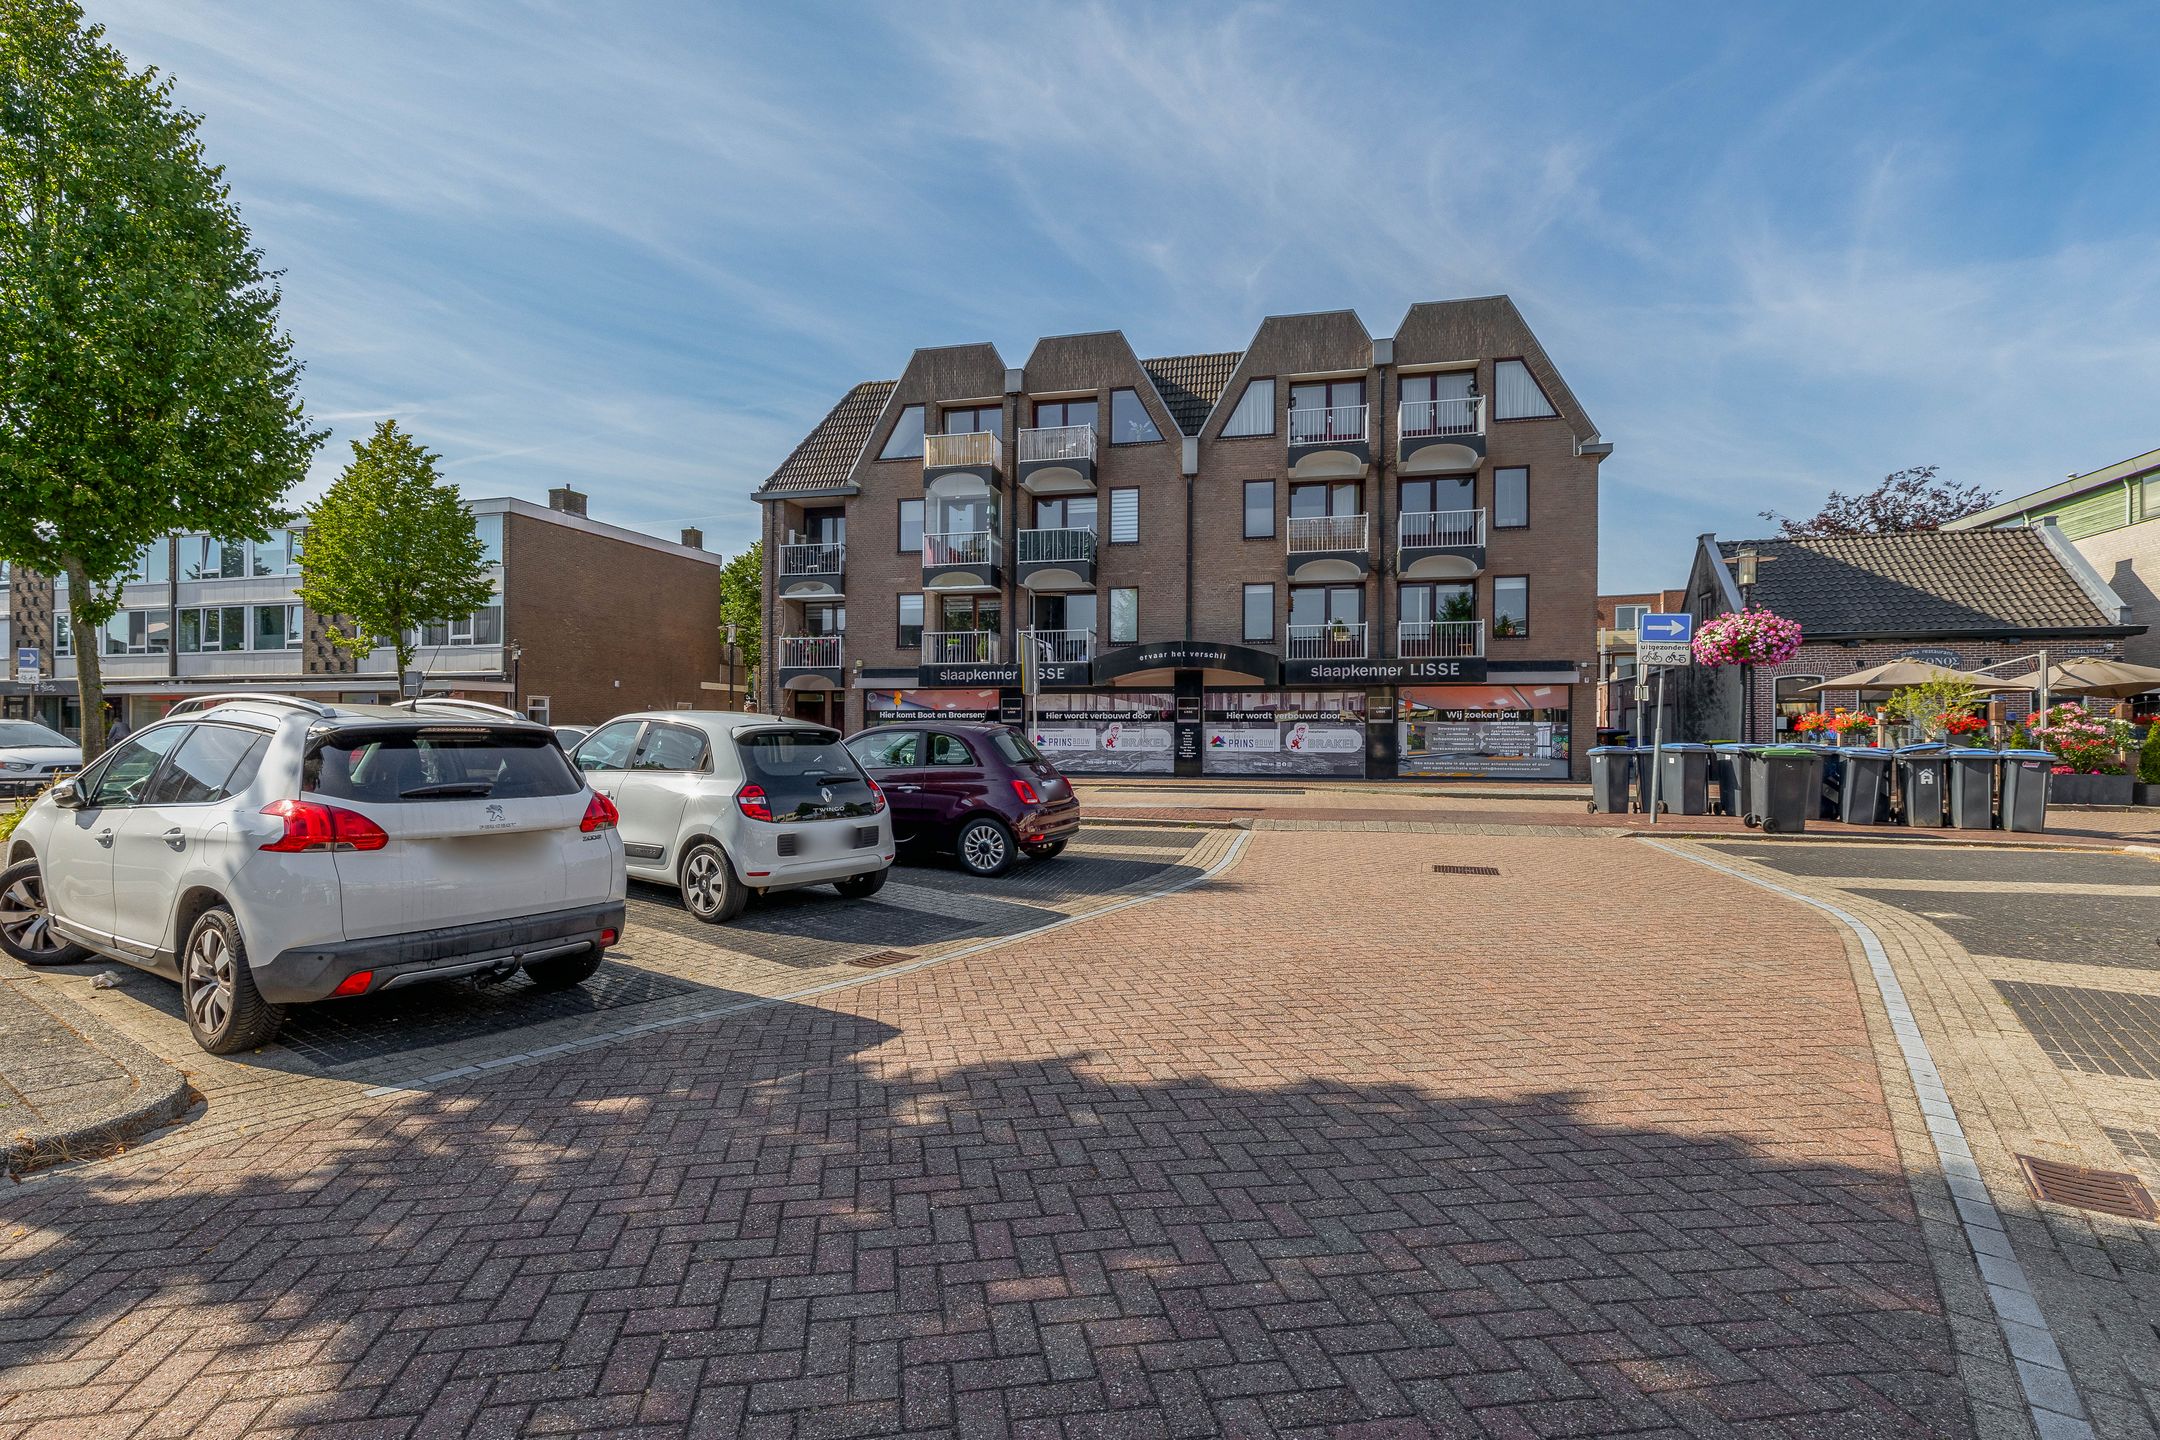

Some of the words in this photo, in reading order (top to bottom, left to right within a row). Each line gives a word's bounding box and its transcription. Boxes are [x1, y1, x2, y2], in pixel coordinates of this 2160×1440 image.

[1139, 651, 1168, 661] ervaar
[1189, 651, 1226, 660] verschil
[939, 669, 1018, 682] slaapkenner
[1038, 667, 1065, 680] SSE
[1310, 664, 1404, 679] slaapkenner
[1410, 662, 1460, 677] LISSE
[879, 711, 896, 719] Hier
[896, 711, 916, 719] komt
[917, 711, 936, 719] Boot
[948, 711, 985, 719] Broersen:
[1045, 711, 1063, 719] Hier
[1063, 711, 1088, 719] wordt
[1089, 711, 1131, 719] verbouwd
[1132, 711, 1152, 719] door
[1226, 711, 1244, 719] Hier
[1245, 711, 1272, 719] wordt
[1274, 711, 1319, 719] verbouwd
[1320, 711, 1341, 719] door
[1446, 711, 1462, 720] Wij
[1464, 710, 1499, 719] zoeken
[1500, 710, 1519, 720] jou!
[1048, 738, 1072, 747] PRINS
[1121, 738, 1166, 747] BRAKEL
[1228, 739, 1254, 748] PRINS
[1254, 739, 1274, 747] BOUW
[1308, 739, 1357, 749] BRAKEL
